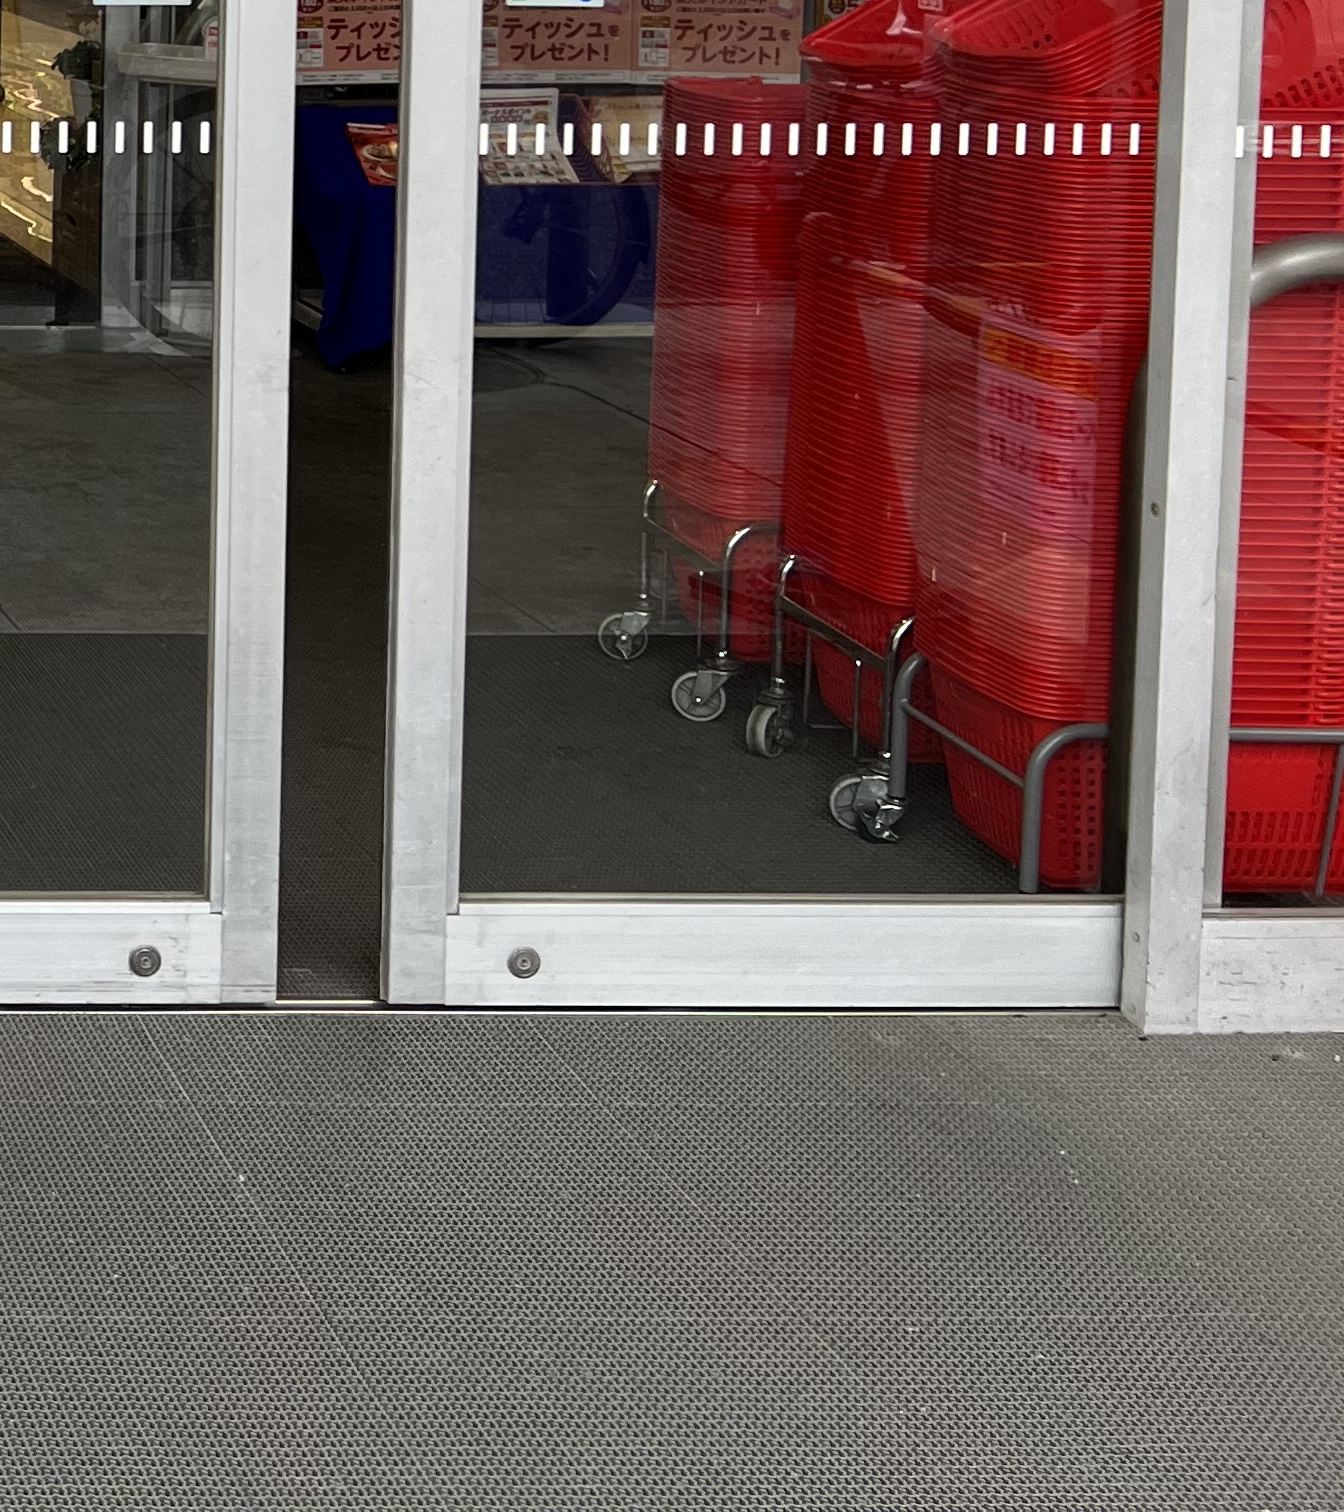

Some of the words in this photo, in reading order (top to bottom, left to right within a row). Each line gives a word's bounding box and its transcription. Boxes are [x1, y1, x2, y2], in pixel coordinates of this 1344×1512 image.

[510, 42, 610, 62] プレゼント!
[681, 44, 780, 66] プレゼント!
